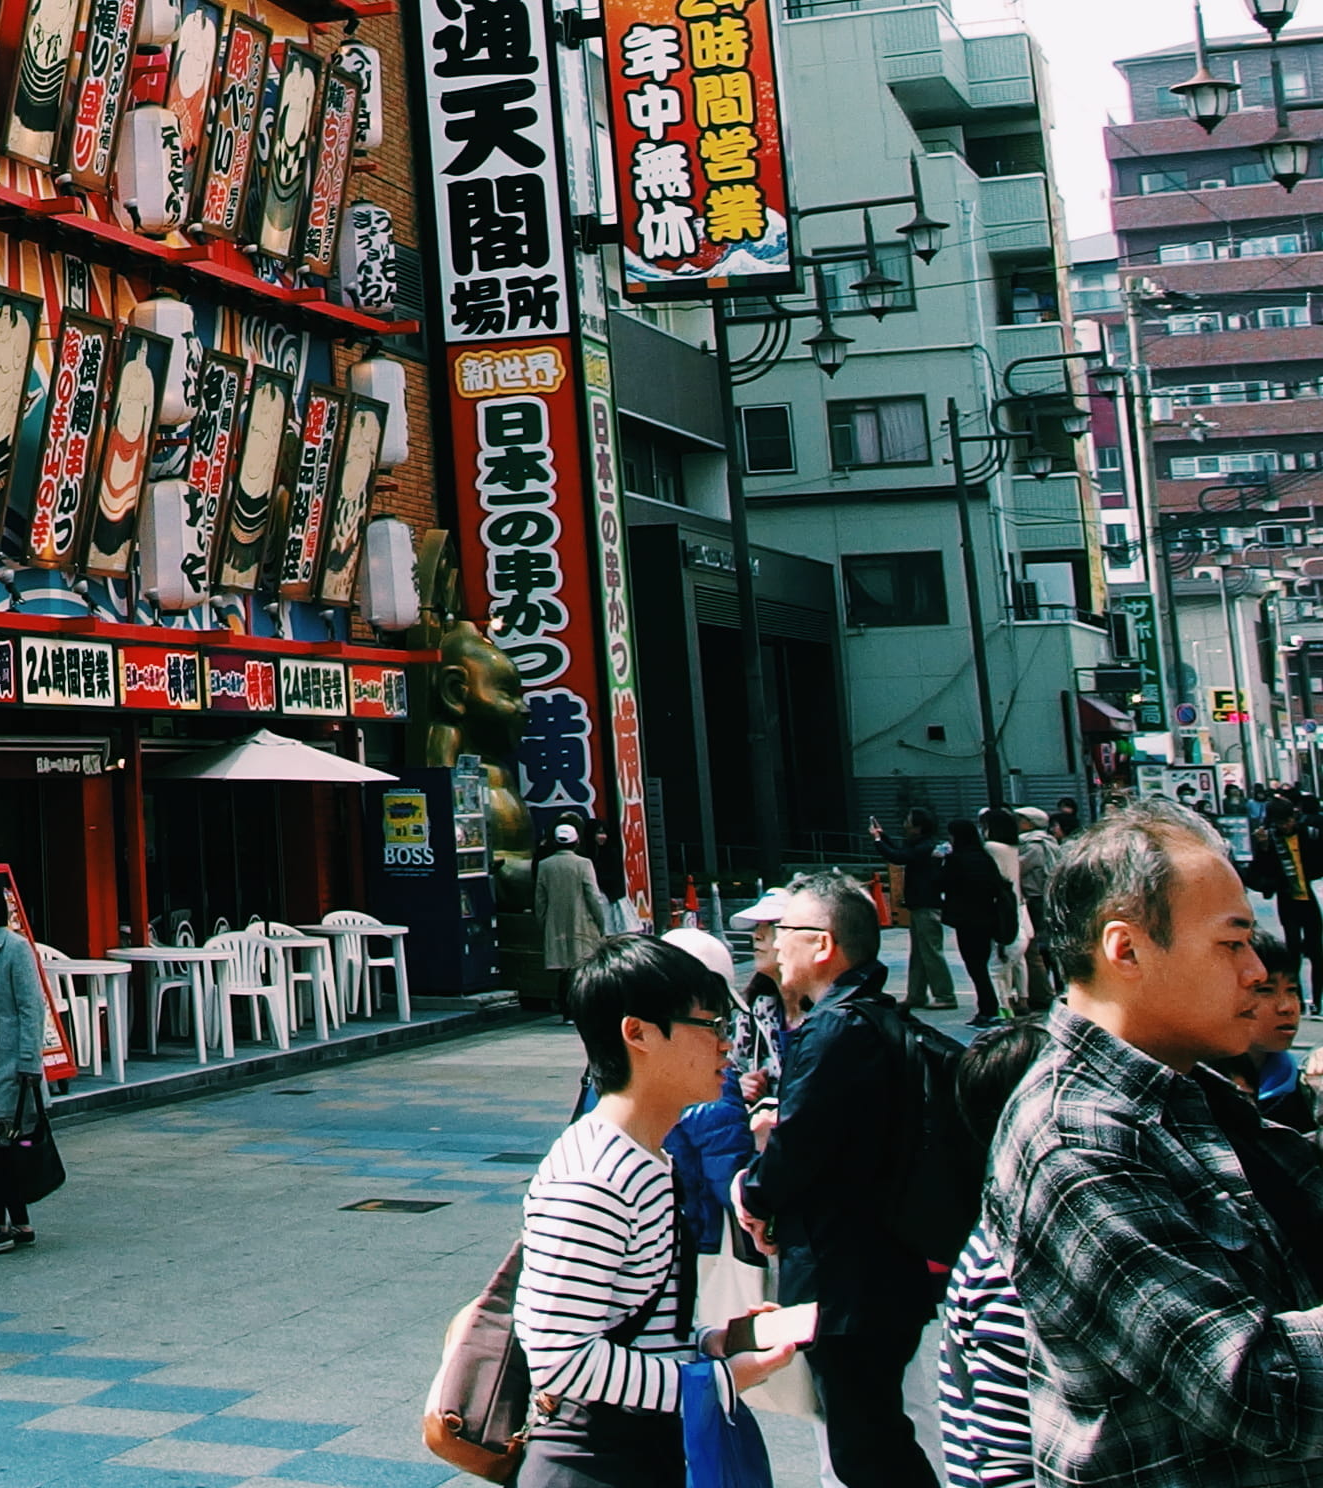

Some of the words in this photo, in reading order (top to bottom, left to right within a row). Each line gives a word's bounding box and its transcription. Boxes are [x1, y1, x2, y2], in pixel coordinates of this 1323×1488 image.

[622, 24, 697, 261] 年中無休
[449, 274, 560, 336] 場所
[460, 350, 561, 394] 新世界
[29, 327, 83, 551] 海の幸山の幸
[52, 329, 106, 555] 横綱串かつ
[481, 399, 566, 686] 日本一の串かつ
[590, 399, 630, 680] 日本一の串かつ
[24, 643, 114, 700] 24時間営業
[165, 651, 199, 707] 横綱
[281, 664, 346, 715] 24時間営業
[383, 847, 435, 865] BOSS
